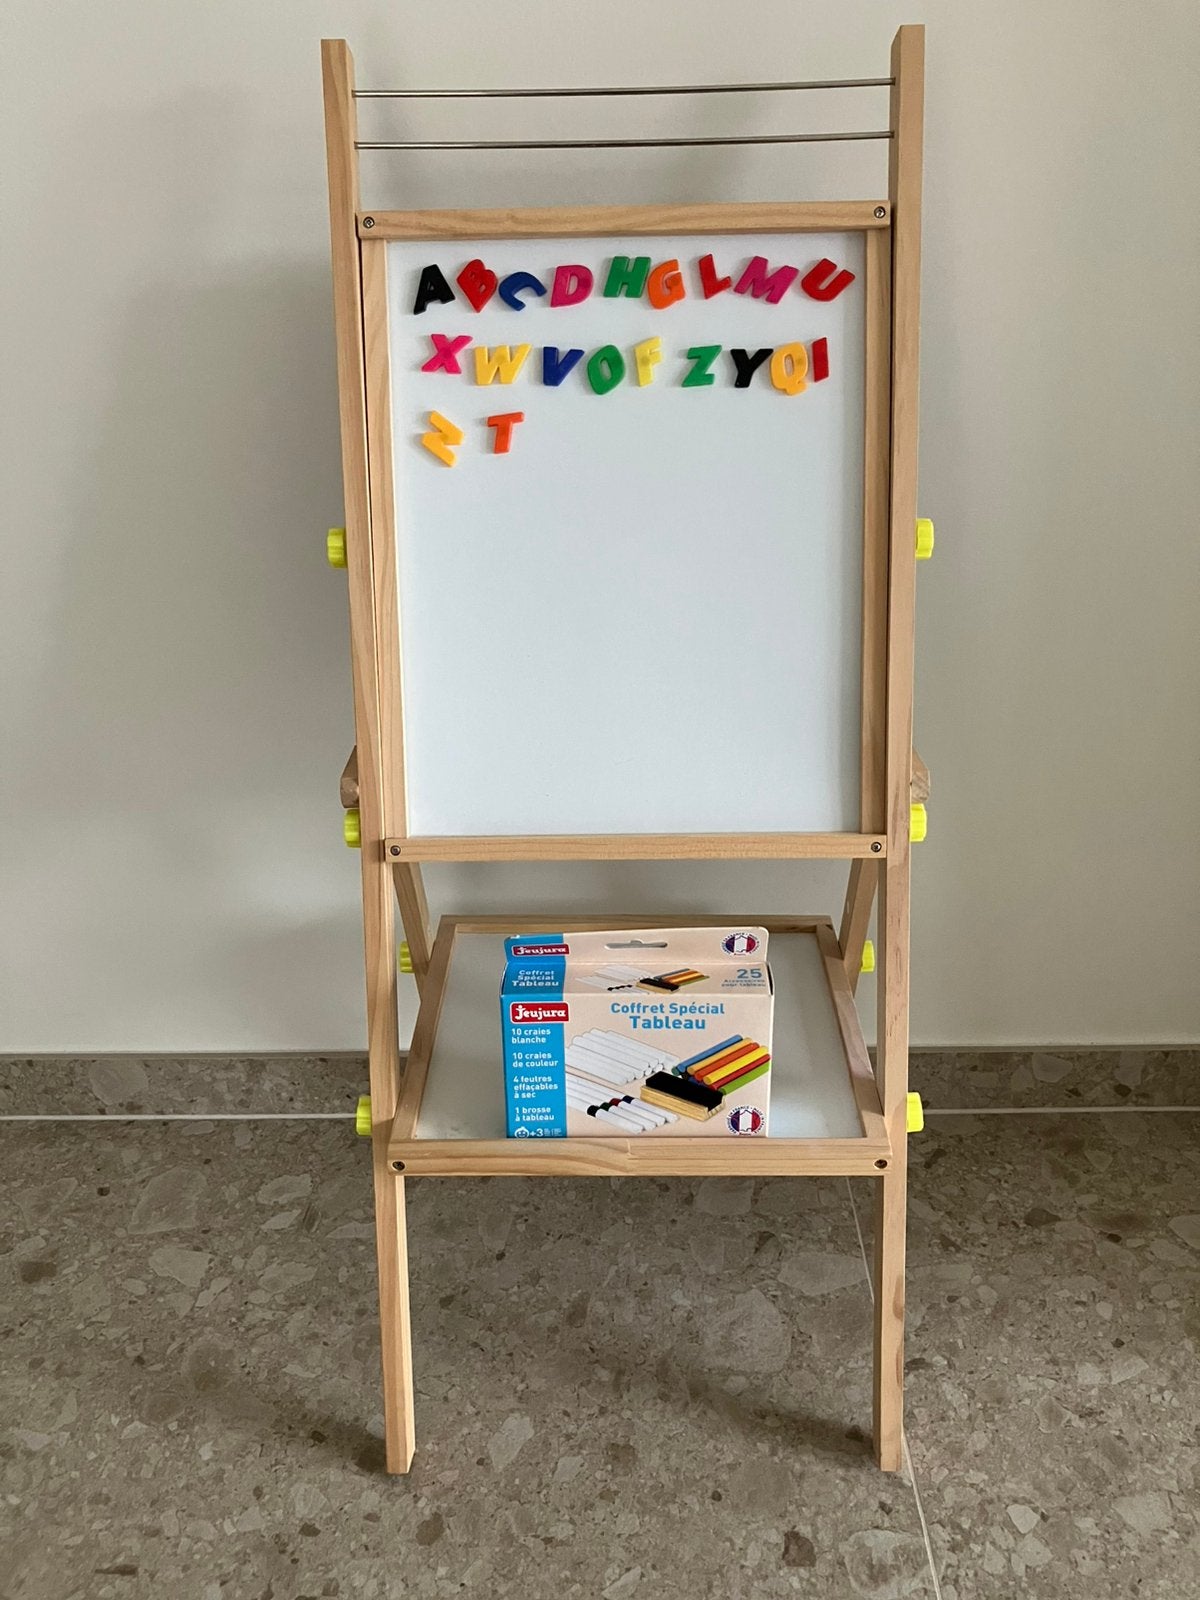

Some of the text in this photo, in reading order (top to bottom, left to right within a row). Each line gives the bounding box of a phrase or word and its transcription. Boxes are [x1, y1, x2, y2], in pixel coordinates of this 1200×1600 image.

[737, 968, 762, 979] 25
[515, 1004, 566, 1020] Jeujura
[611, 1002, 725, 1016] Coffret Spécial
[629, 1015, 706, 1029] Tableau
[512, 1036, 546, 1044] blanche
[512, 1052, 523, 1060] 10
[512, 1060, 523, 1068] de
[521, 1075, 552, 1083] feutres
[514, 1082, 558, 1091] effaçables
[514, 1090, 519, 1099] à
[515, 1113, 555, 1122] à tableau
